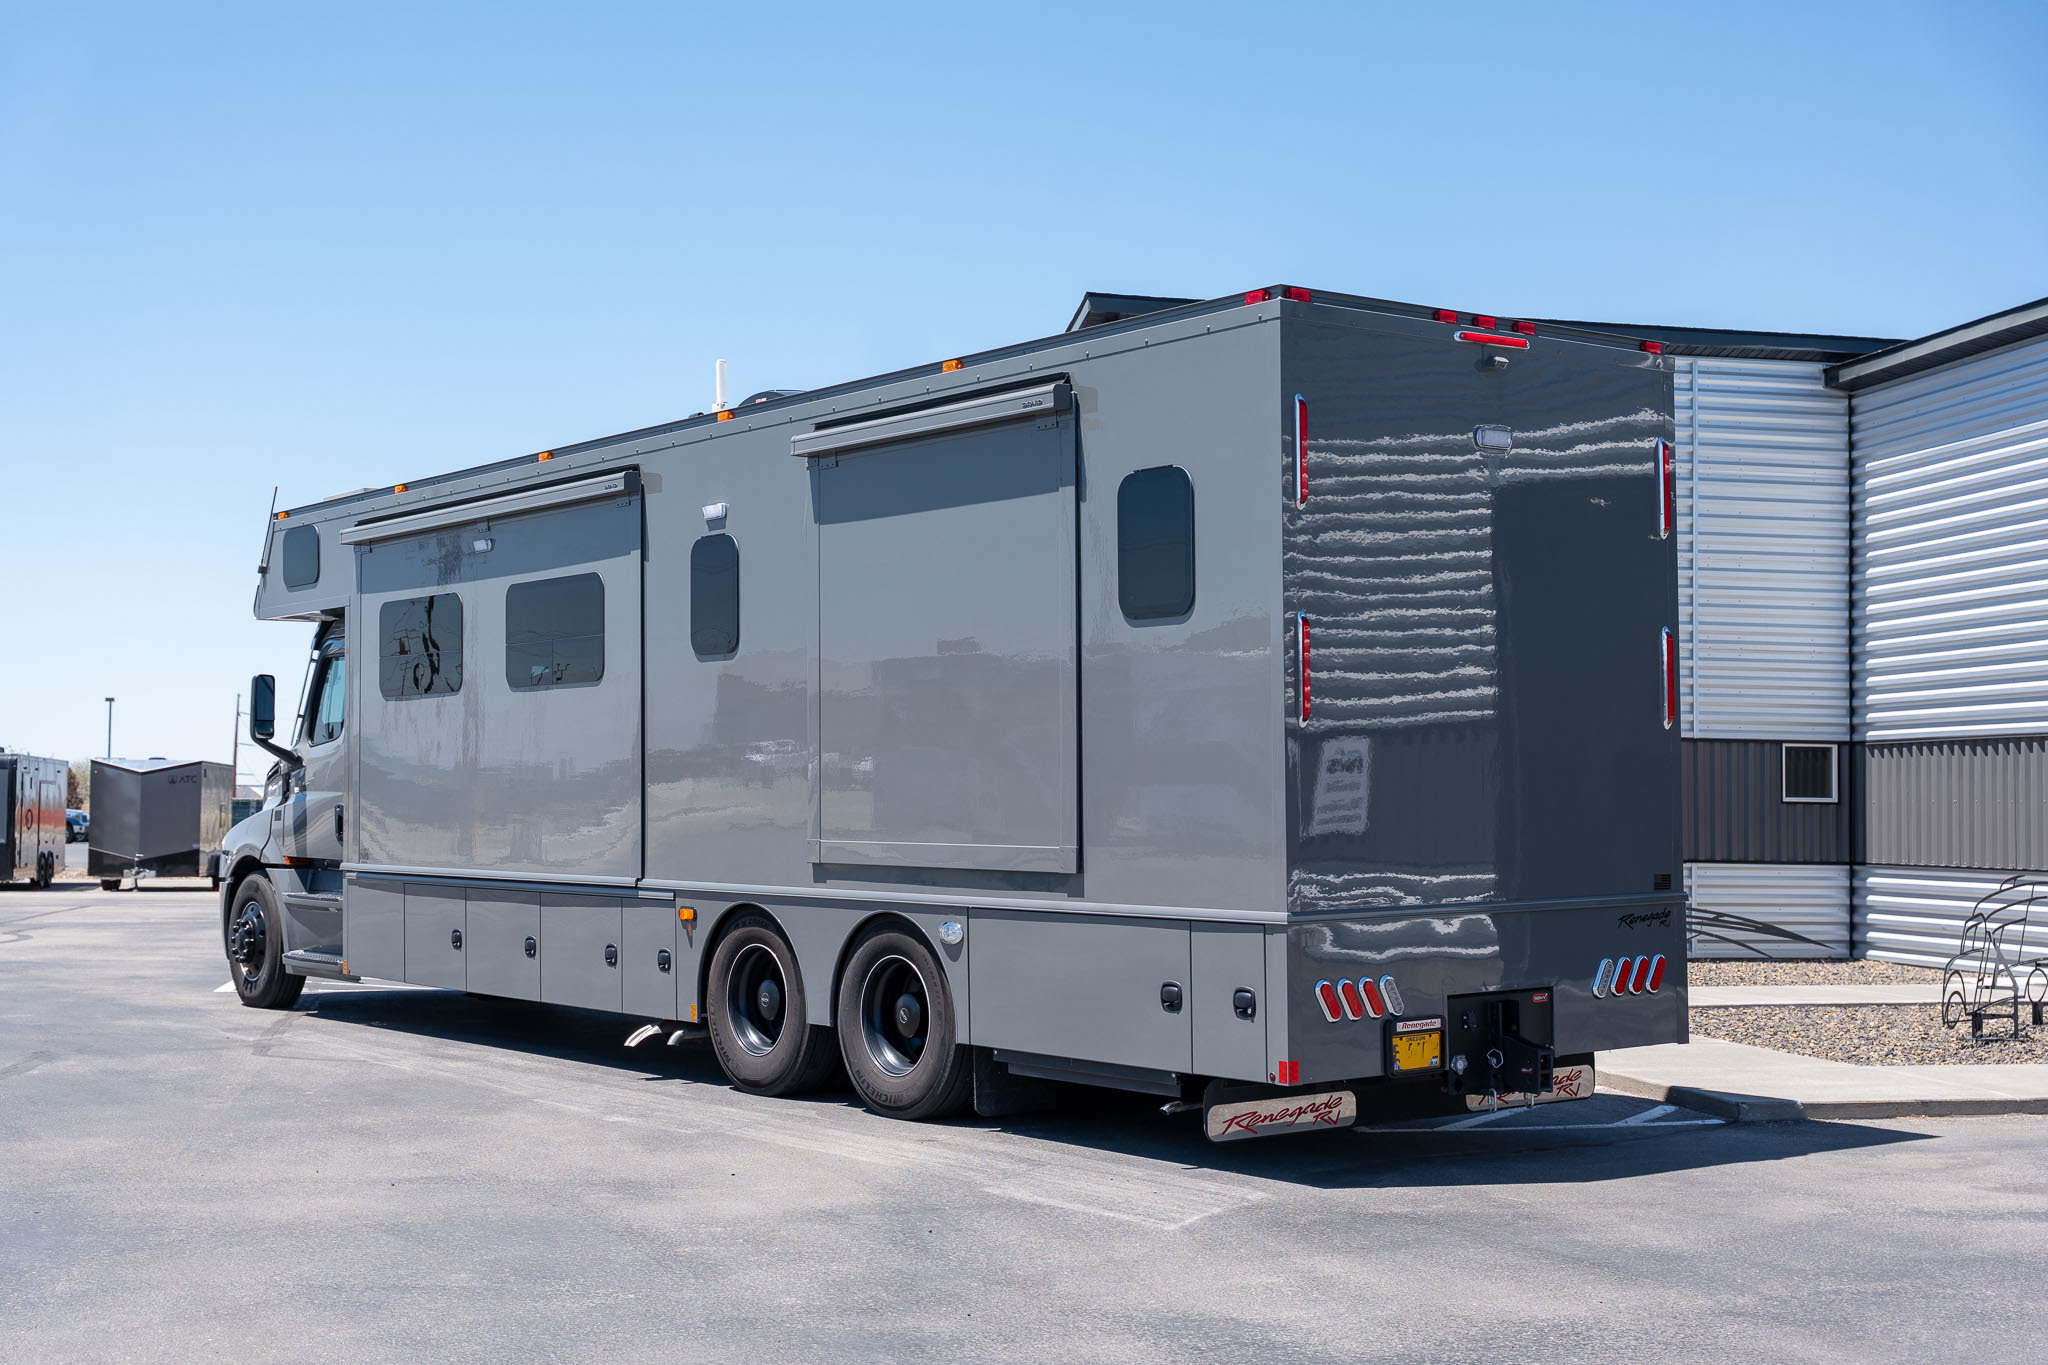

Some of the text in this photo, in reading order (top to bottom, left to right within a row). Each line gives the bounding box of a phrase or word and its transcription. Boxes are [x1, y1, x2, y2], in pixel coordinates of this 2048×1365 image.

[178, 775, 199, 784] ATC
[1617, 907, 1672, 930] Renegade
[1401, 1020, 1437, 1030] Renegade
[855, 1069, 904, 1105] MICHELIN
[1556, 1082, 1580, 1097] RV
[1222, 1094, 1343, 1136] Renegade
[1312, 1110, 1341, 1126] RV
